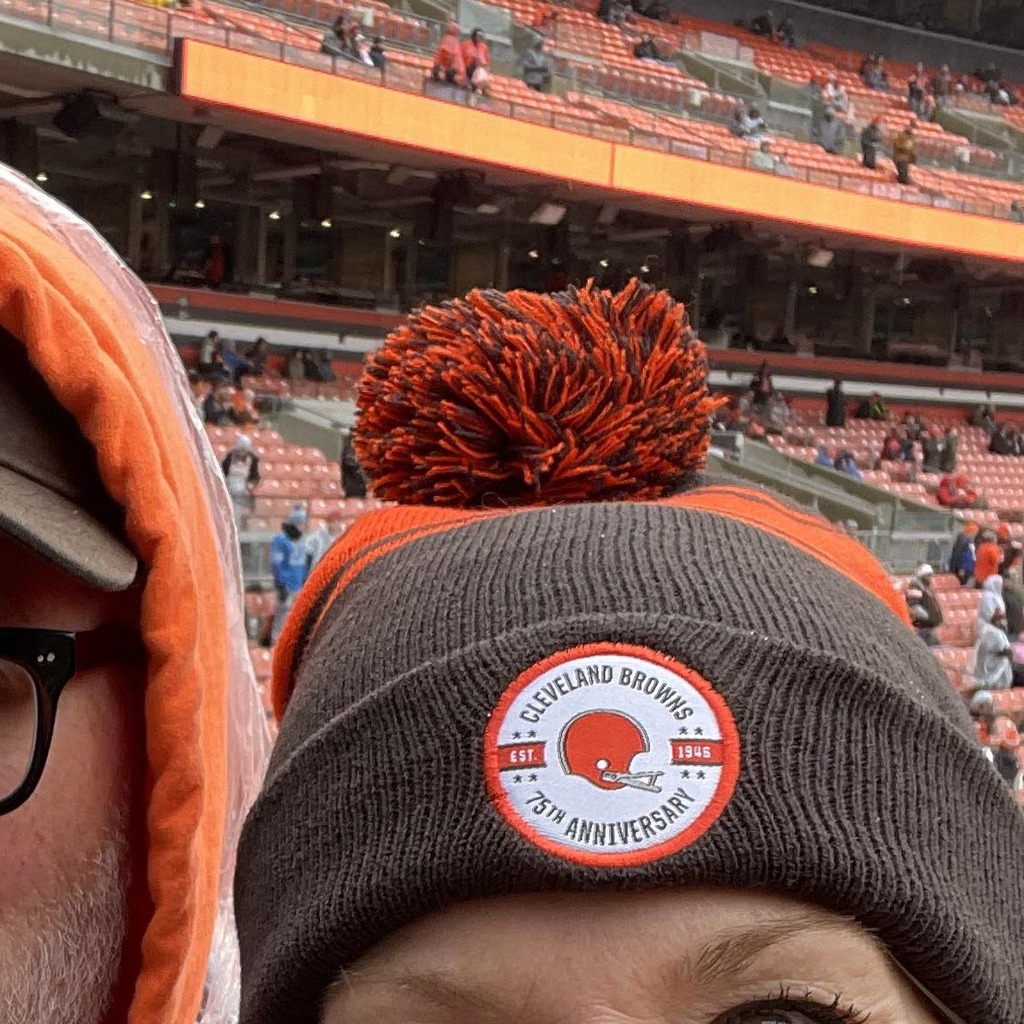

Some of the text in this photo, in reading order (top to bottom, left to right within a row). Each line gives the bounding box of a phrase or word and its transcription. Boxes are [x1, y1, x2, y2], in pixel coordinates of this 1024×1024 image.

[520, 664, 694, 724] CLEVELAND BROWNS
[509, 749, 538, 763] EST.
[678, 745, 712, 759] 1946
[526, 787, 696, 846] 75TH ANNIVERSARY
